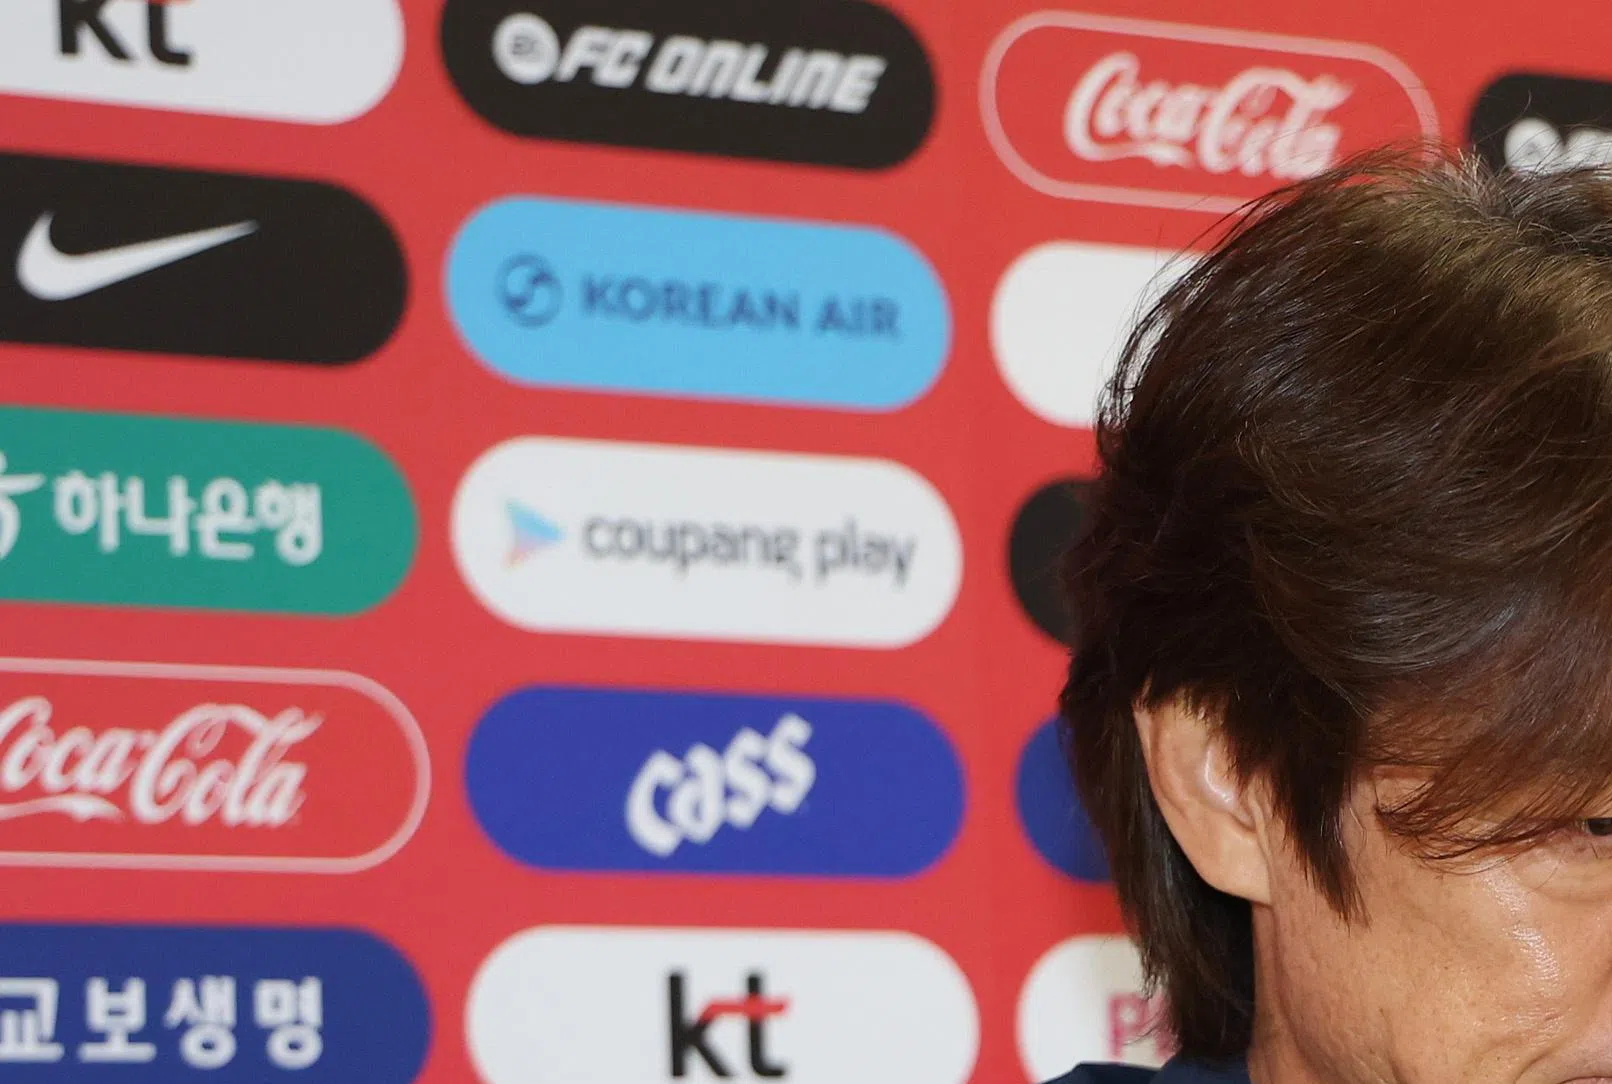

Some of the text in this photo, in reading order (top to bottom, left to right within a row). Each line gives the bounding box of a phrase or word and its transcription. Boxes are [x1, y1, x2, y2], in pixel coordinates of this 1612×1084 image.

[553, 26, 885, 112] FC ONLINE
[1063, 50, 1351, 180] Coca-Cola
[581, 277, 903, 338] KOREAN AIR
[53, 470, 323, 565] 하나은행
[582, 513, 916, 590] coupang play
[0, 976, 323, 1069] 교보생명
[664, 968, 792, 1082] kt
